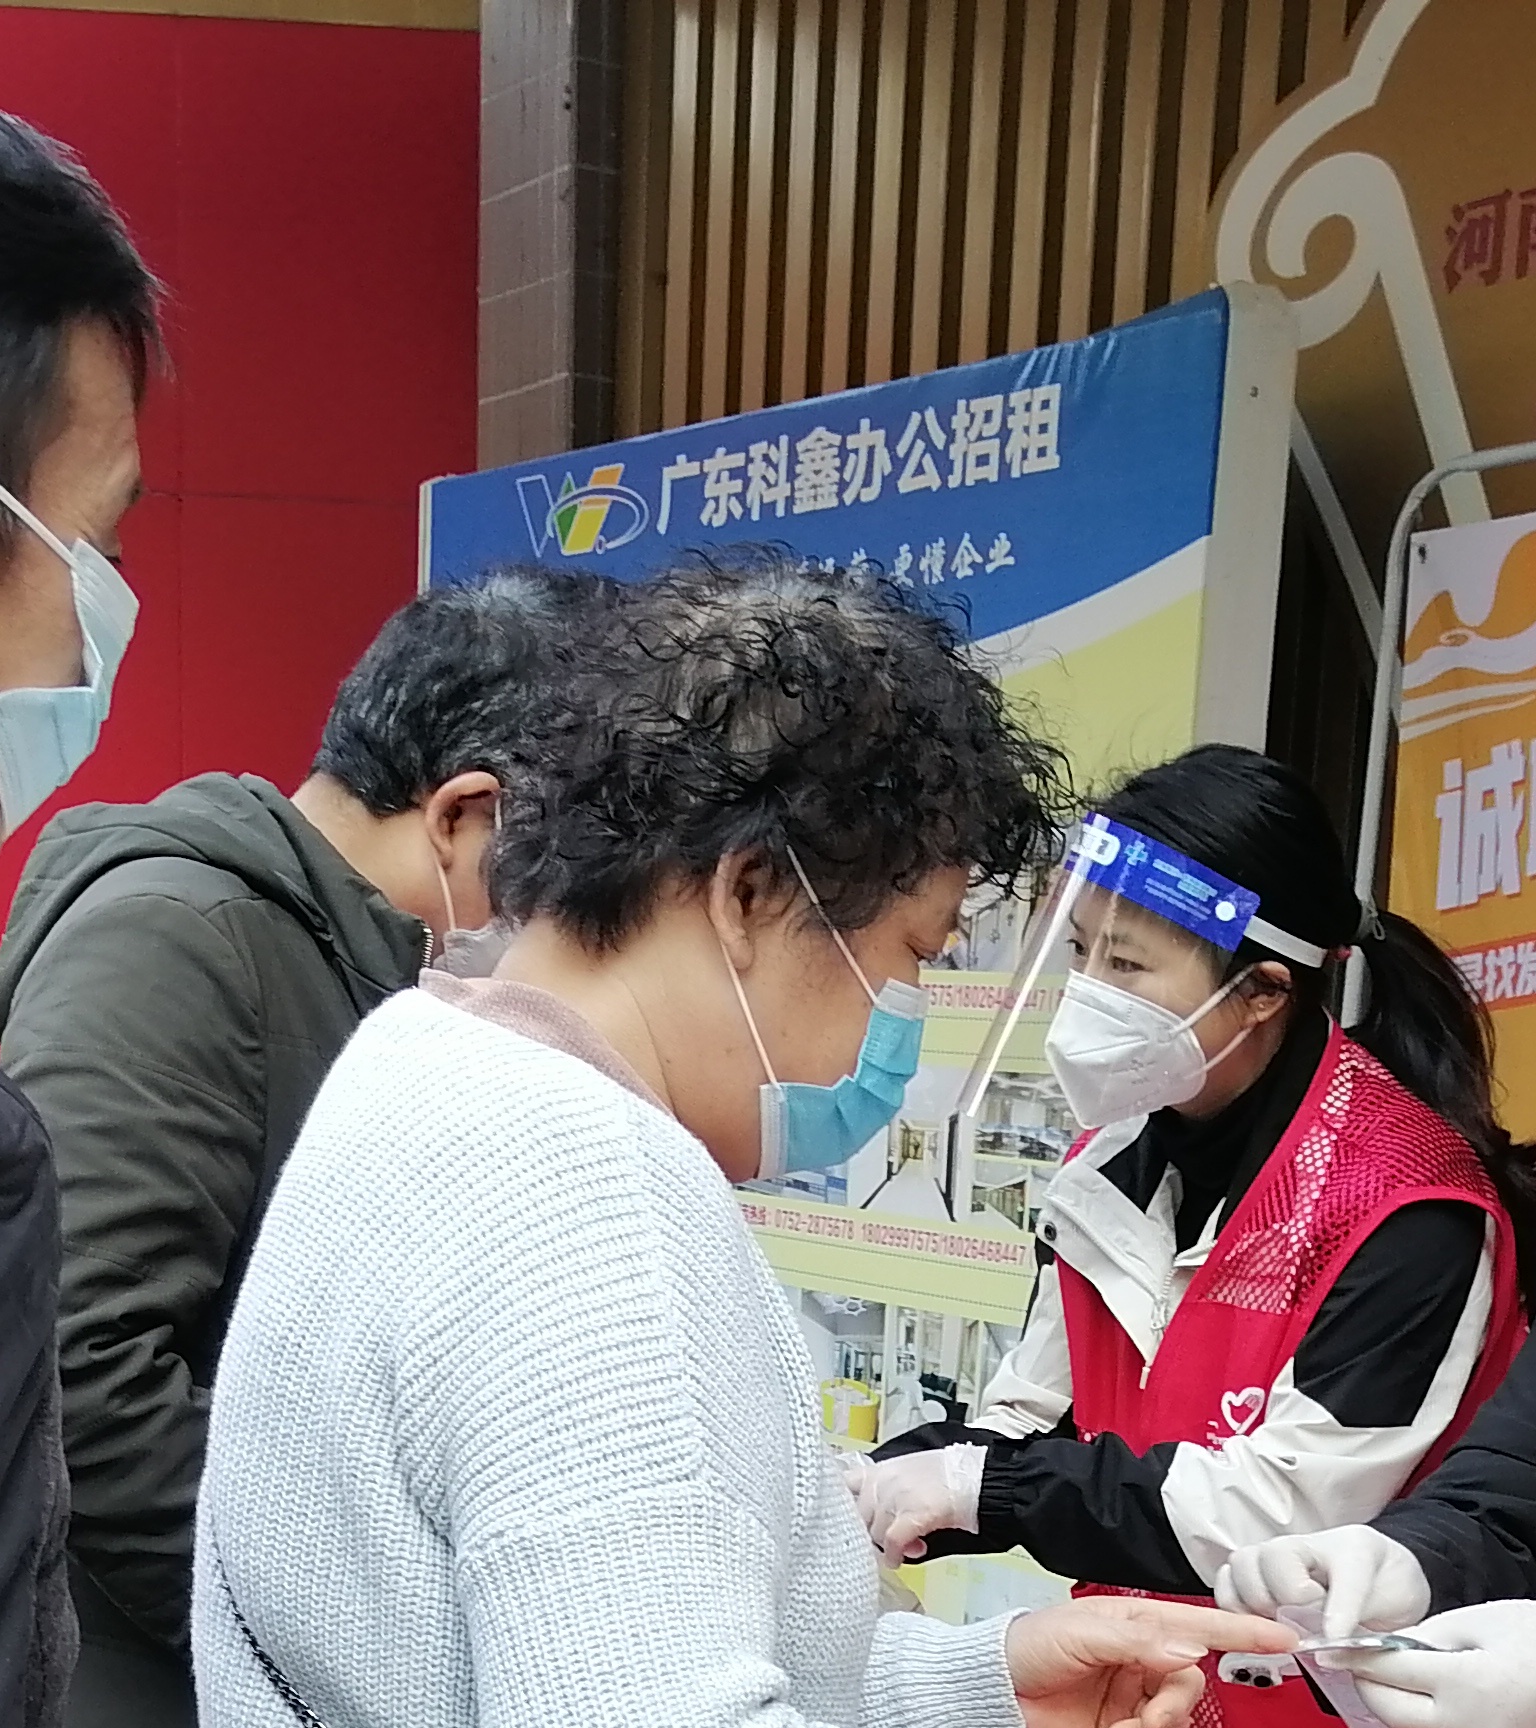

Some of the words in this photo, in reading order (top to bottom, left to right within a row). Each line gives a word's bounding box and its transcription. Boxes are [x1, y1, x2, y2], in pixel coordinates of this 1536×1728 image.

[656, 385, 1061, 535] 广东科鑫办公招租
